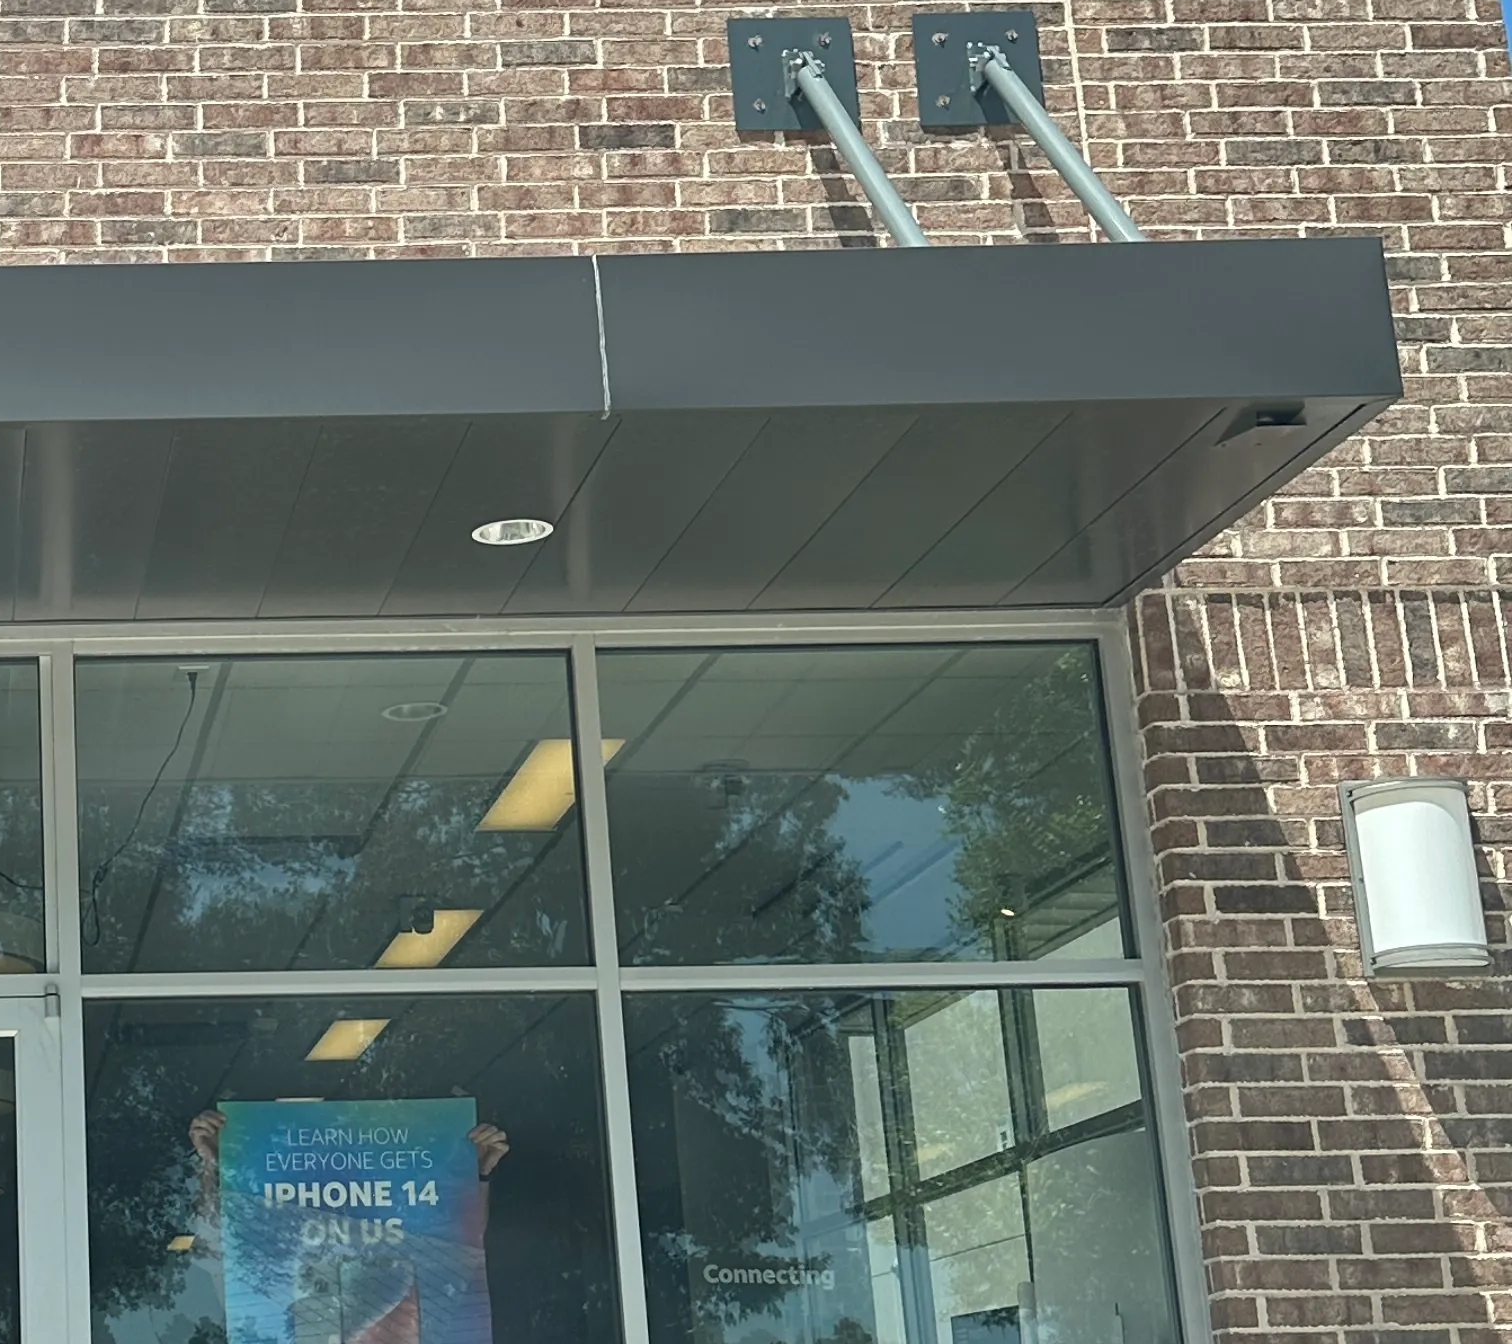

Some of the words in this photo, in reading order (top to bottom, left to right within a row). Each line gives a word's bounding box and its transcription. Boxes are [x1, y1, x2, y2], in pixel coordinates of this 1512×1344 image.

[287, 1128, 353, 1146] LEARN
[358, 1127, 409, 1145] HOW
[265, 1151, 375, 1172] EVERYONE
[380, 1150, 433, 1169] GETS
[264, 1180, 393, 1209] IPHONE
[401, 1180, 439, 1206] 14
[300, 1218, 351, 1246] ON
[360, 1217, 405, 1244] US
[703, 1263, 835, 1291] Connecting
